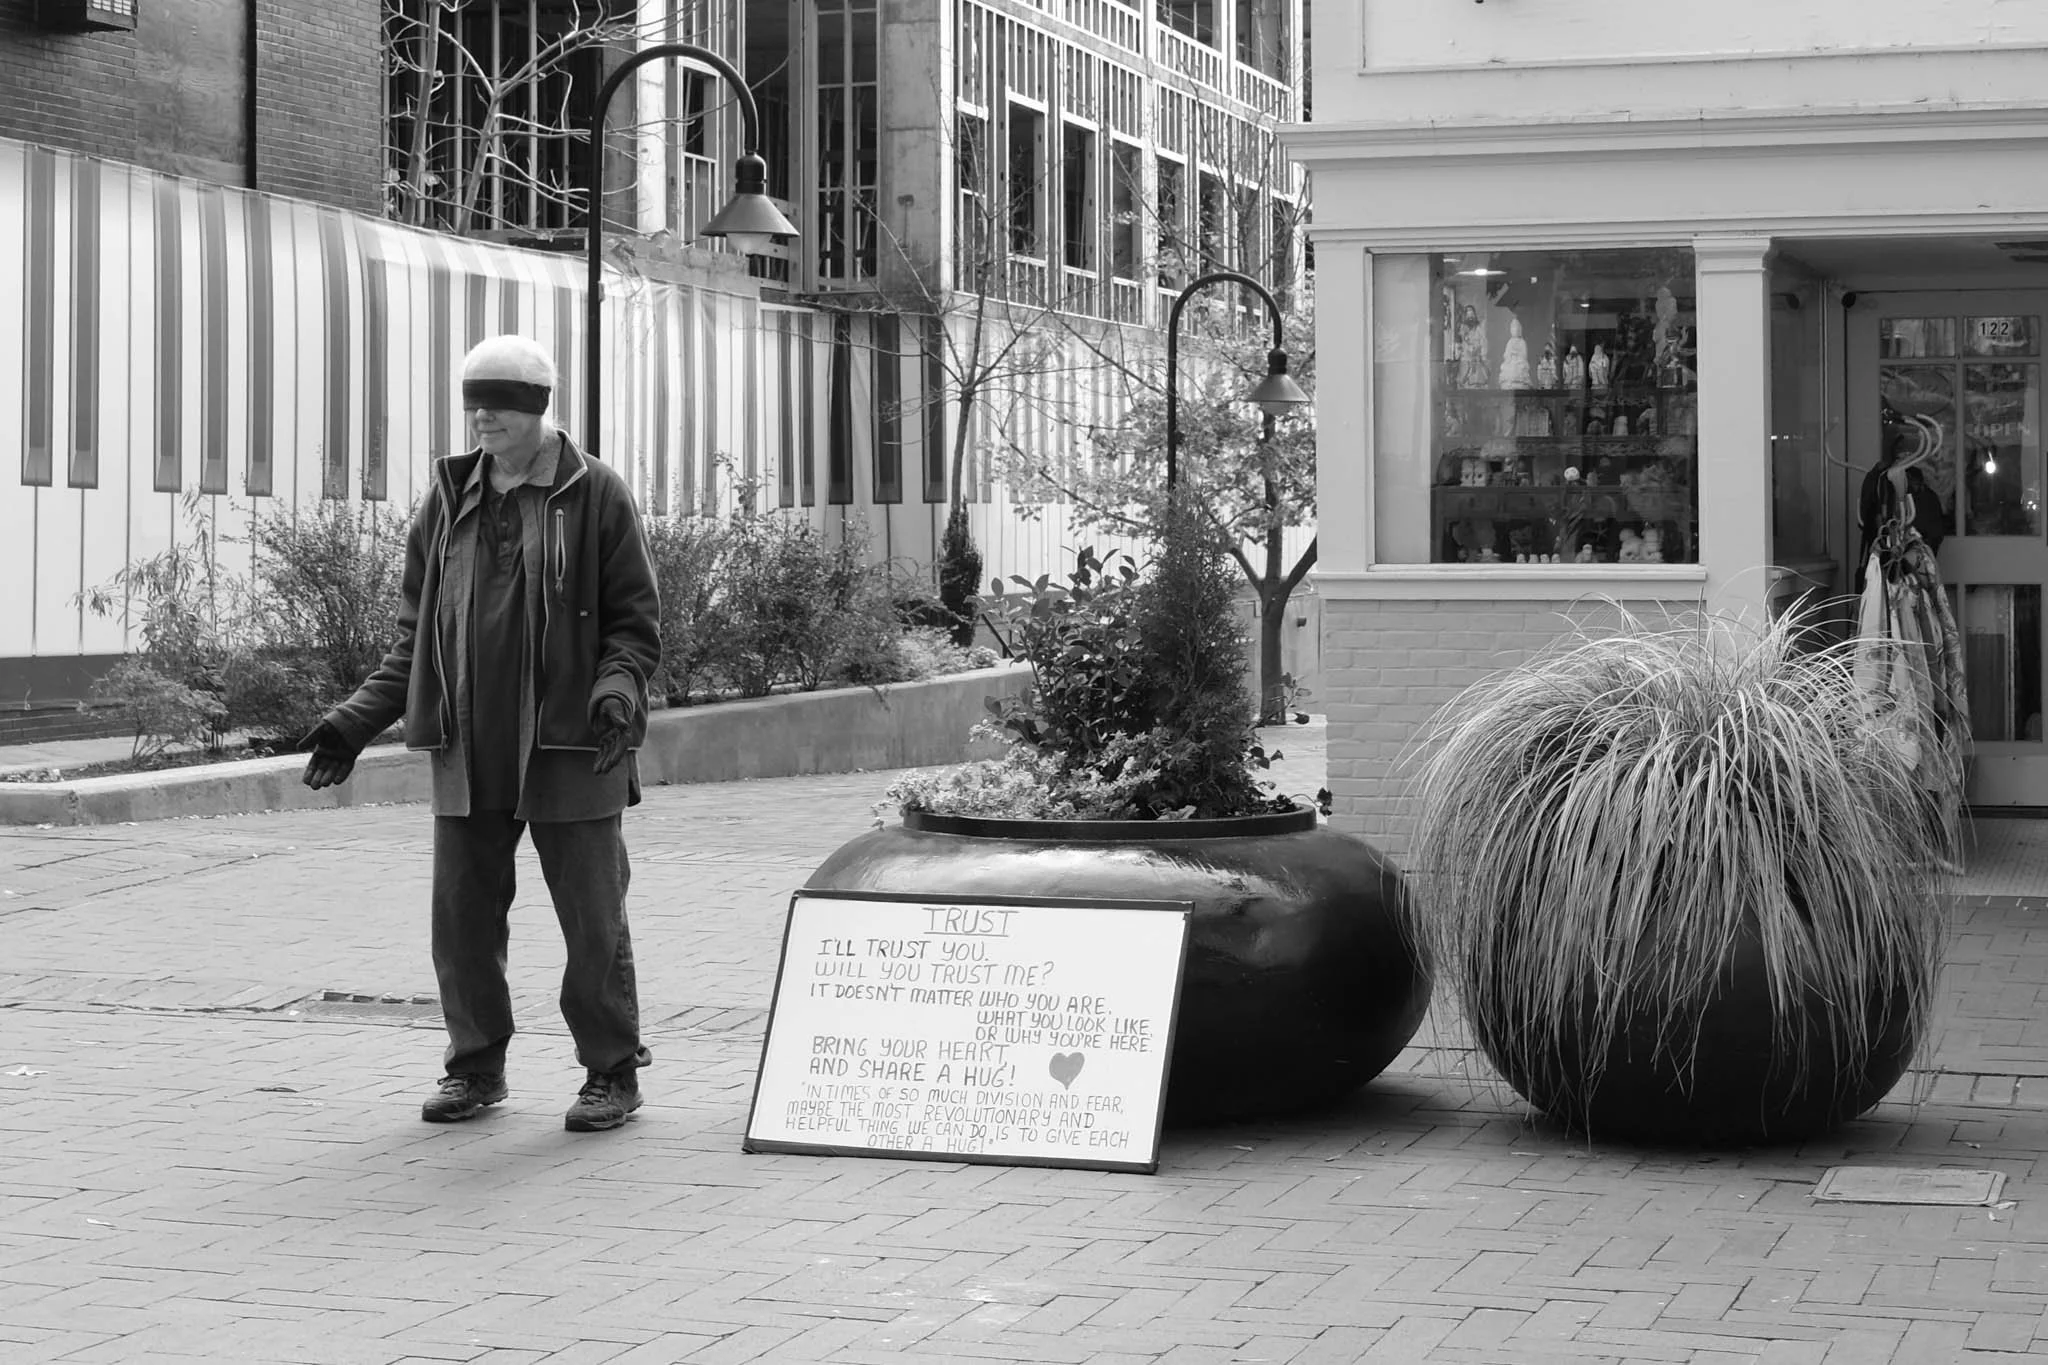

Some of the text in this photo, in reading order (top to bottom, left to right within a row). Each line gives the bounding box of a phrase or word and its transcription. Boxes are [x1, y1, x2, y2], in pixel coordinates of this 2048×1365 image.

[1980, 322, 2009, 336] 122
[922, 908, 1020, 934] TRUST
[817, 939, 990, 962] I'LL TRUST YOU.
[815, 961, 1055, 987] WILL YOU TRUST ME?
[810, 983, 829, 999] IT
[835, 984, 905, 1002] DOESN'T
[910, 988, 973, 1007] MATTER
[979, 991, 1020, 1008] WHO
[1026, 992, 1059, 1012] YOU
[977, 1010, 1028, 1026] WHAT
[1029, 1013, 1063, 1030] YOU
[1067, 1015, 1106, 1033] LOOK
[812, 1036, 867, 1057] BRING
[881, 1039, 927, 1060] YOUR
[976, 1026, 998, 1041] OR
[1005, 1027, 1041, 1045] WHY
[1048, 1031, 1102, 1049] YOU'RE
[809, 1057, 1016, 1087] AND SHARE A HUG!
[826, 1084, 871, 1101] TIMES
[879, 1086, 893, 1100] OF
[899, 1087, 919, 1102] SO
[927, 1088, 968, 1104] MUCH
[976, 1090, 1043, 1109] DIVISION
[1049, 1093, 1080, 1110] AND
[1087, 1095, 1124, 1114] FEAR,
[786, 1100, 1095, 1129] MAYBE THE MOST REVOLUTIONARY AND
[785, 1116, 853, 1132] HELPFUL
[858, 1118, 898, 1135] THING
[907, 1121, 929, 1135] WE
[935, 1122, 964, 1137] CAN
[996, 1125, 1009, 1141] IS
[1018, 1127, 1038, 1142] TO
[1046, 1128, 1082, 1146] GIVE
[1088, 1130, 1129, 1149] EACH
[867, 1134, 914, 1150] OTHER
[922, 1136, 933, 1151] A
